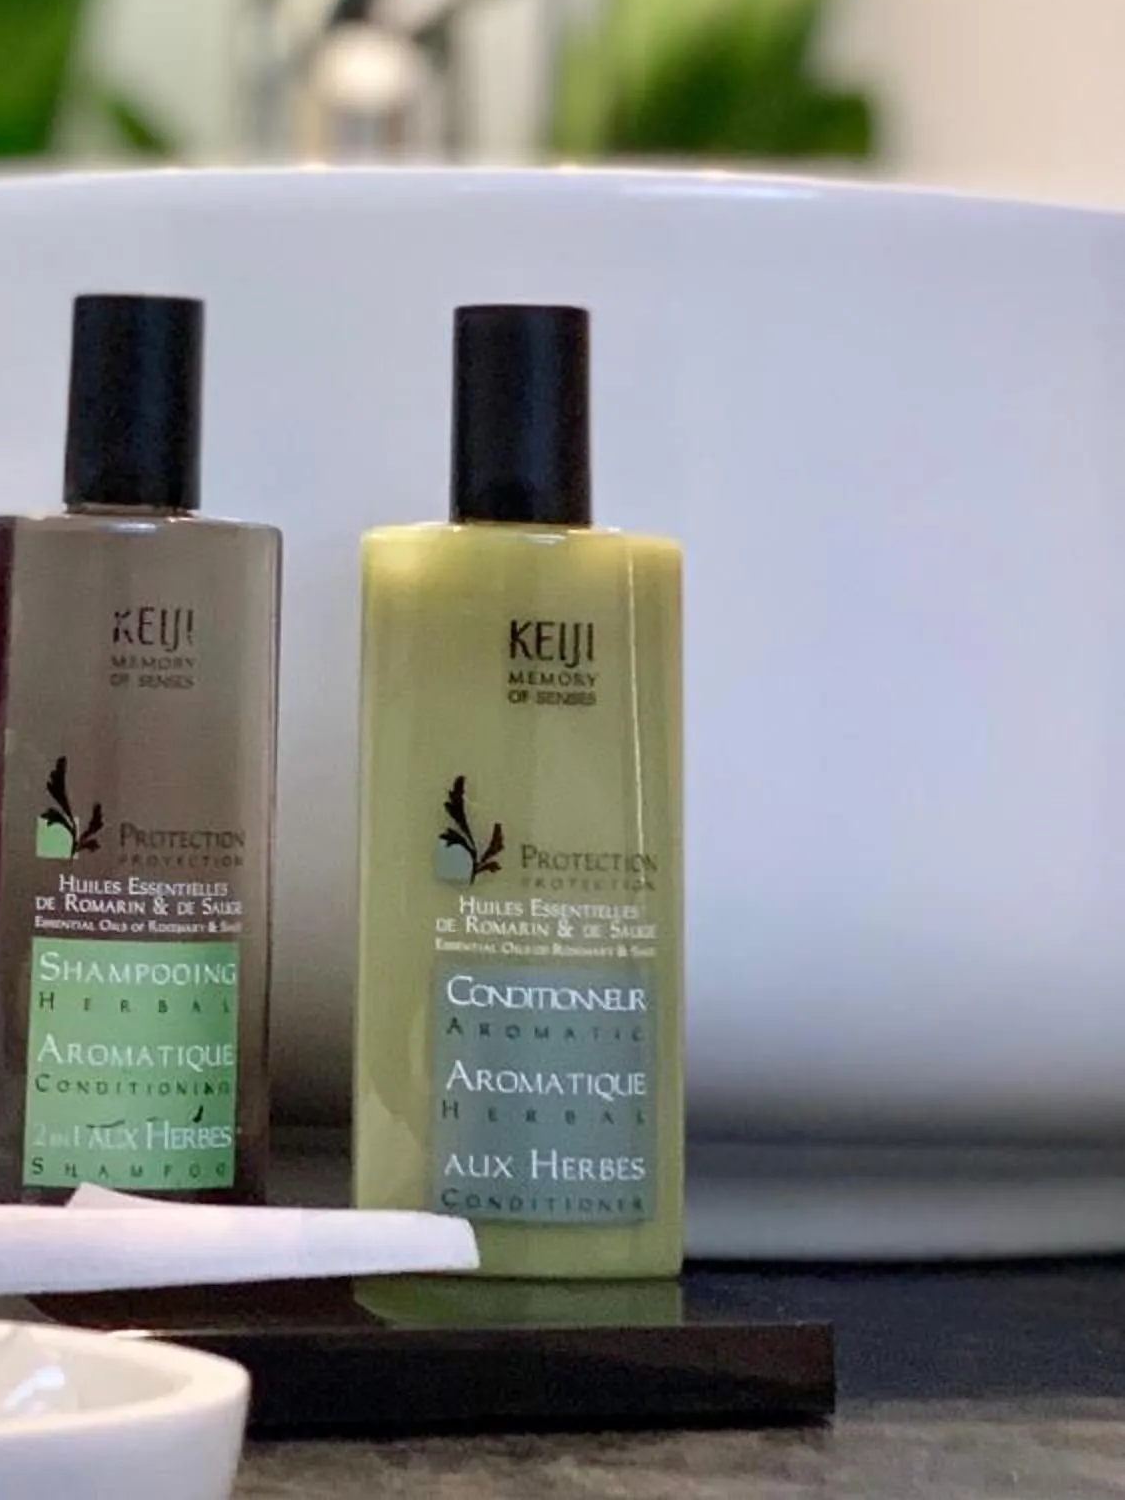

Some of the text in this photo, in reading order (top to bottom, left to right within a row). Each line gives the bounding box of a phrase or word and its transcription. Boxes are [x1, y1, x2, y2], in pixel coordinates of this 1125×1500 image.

[112, 605, 195, 653] KEIJI
[508, 619, 596, 669] KEIJI
[109, 655, 197, 671] MEMORY
[109, 672, 131, 688] OF
[507, 670, 599, 687] MEMORY
[507, 689, 598, 706] OF SENSES
[120, 822, 245, 850] PROTECTION
[521, 844, 658, 874] PROTECTION
[58, 873, 229, 897] HUILES ESSENTIELLES
[35, 895, 56, 911] DE
[65, 893, 146, 915] ROMARIN
[152, 896, 169, 916] &
[176, 900, 196, 916] DE
[459, 896, 640, 920] HUILES ESSENTIELLES
[34, 915, 95, 932] ESSENTIAL
[436, 917, 457, 933] DE
[466, 915, 549, 937] ROMARIN
[556, 918, 574, 937] &
[583, 924, 603, 938] DE
[38, 951, 236, 986] SHAMPOOING
[38, 991, 231, 1014] HERBAL
[446, 975, 647, 1011] CONDITIONNEUR
[446, 1017, 644, 1041] AROMATIC
[36, 1033, 234, 1073] AROMATIQUE
[34, 1073, 231, 1096] CONDITIONING
[446, 1059, 647, 1101] AROMATIQUE
[442, 1100, 645, 1125] HERBAL
[88, 1126, 139, 1150] AUX
[146, 1120, 232, 1152] HERBES
[31, 1156, 231, 1179] SHAMPOO
[443, 1149, 646, 1181] AUX HERBES
[441, 1188, 644, 1214] CONDITIONER
